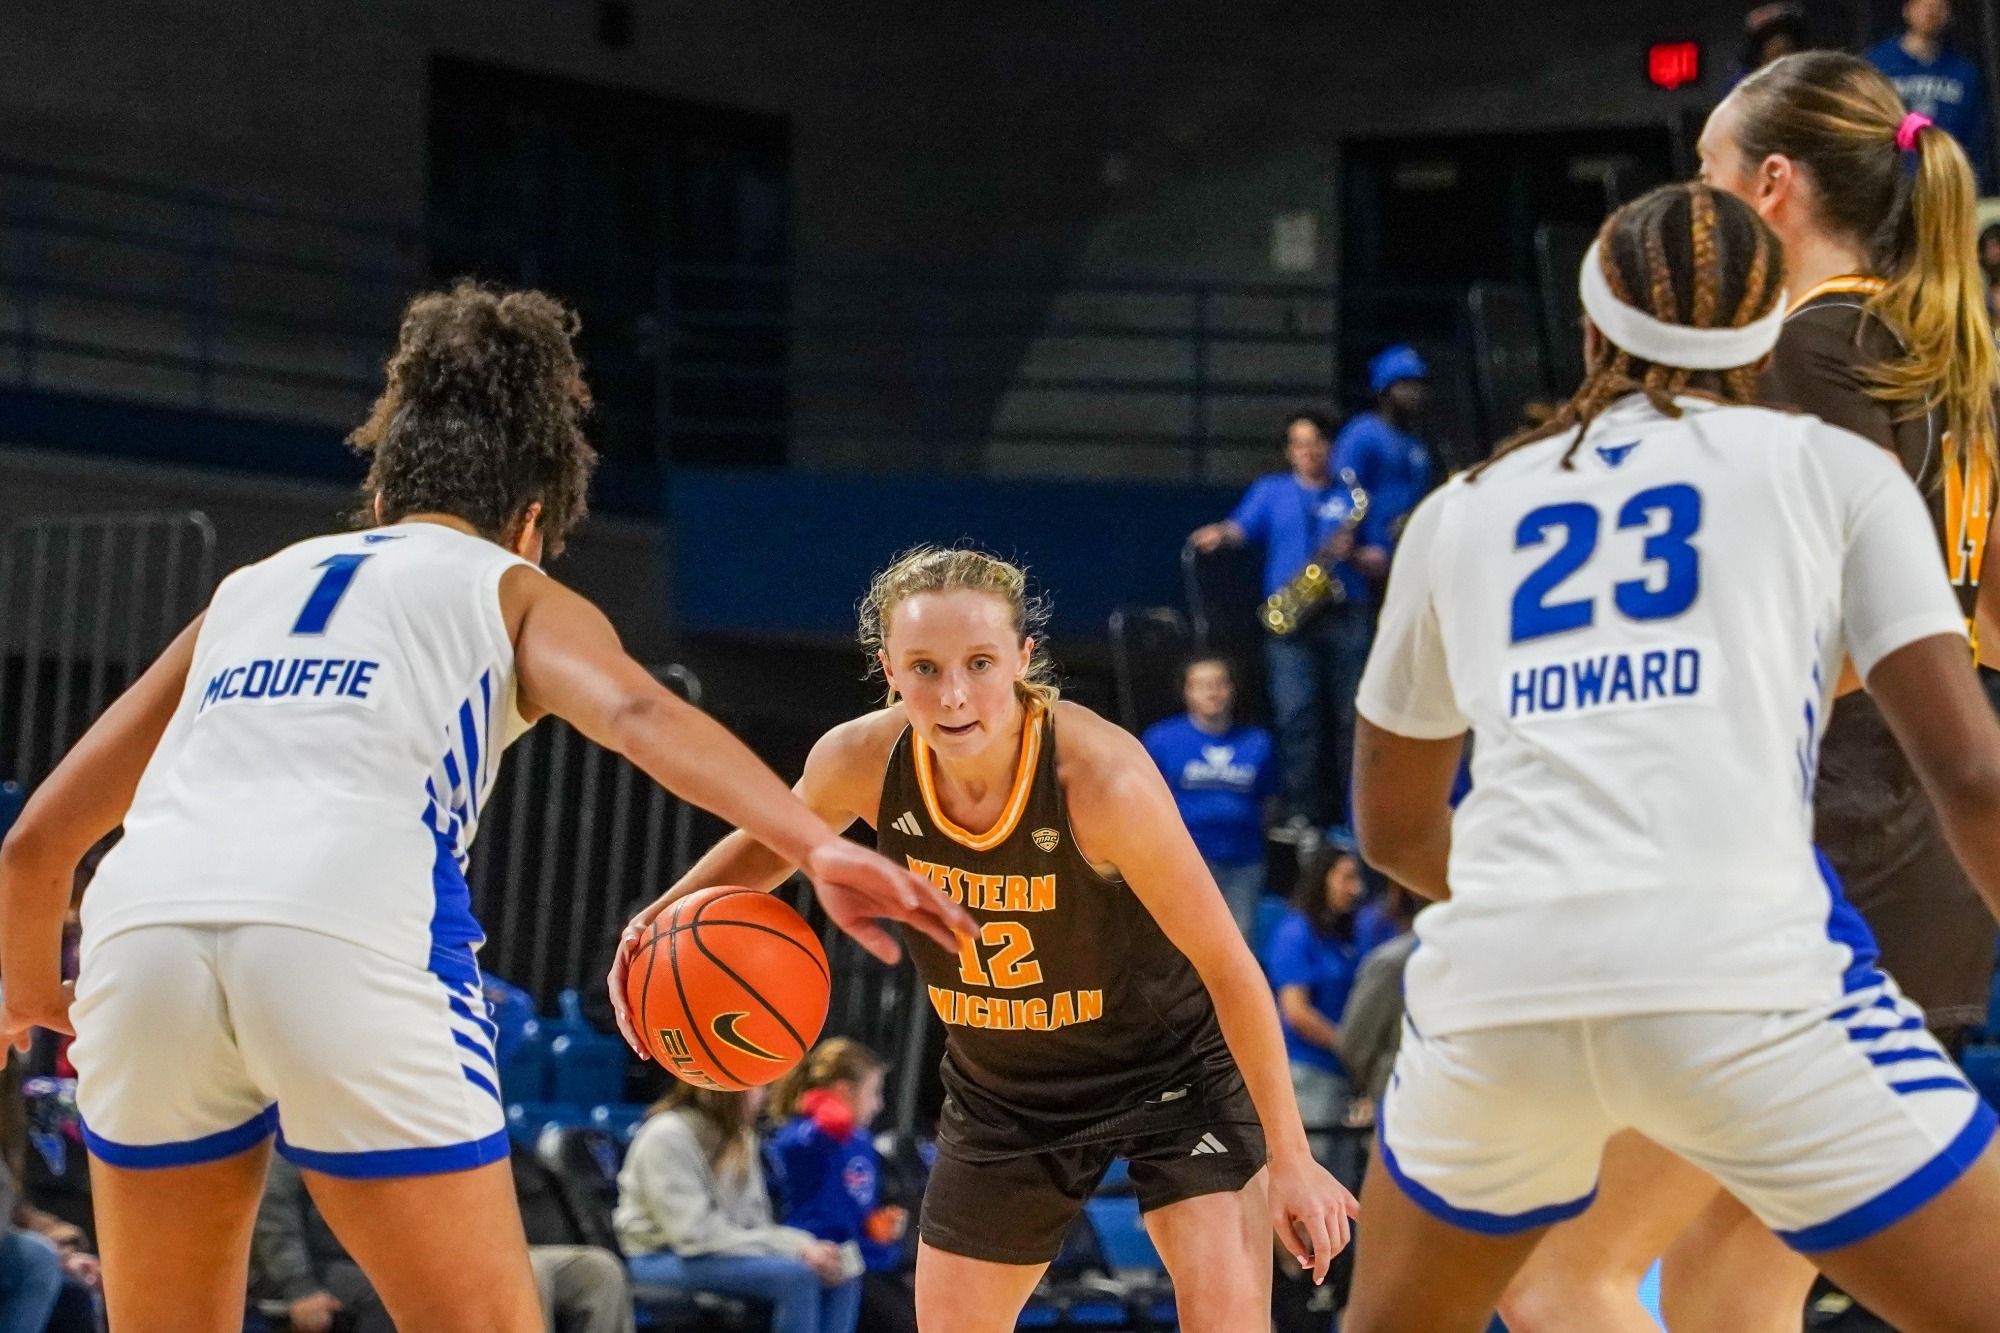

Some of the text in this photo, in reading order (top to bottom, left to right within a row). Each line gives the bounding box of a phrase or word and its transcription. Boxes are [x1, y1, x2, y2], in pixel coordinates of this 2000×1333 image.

[289, 553, 376, 637] 1
[1509, 482, 1703, 646] 23
[1510, 648, 1701, 719] HOWARD
[1035, 835, 1057, 844] MAC
[906, 854, 1056, 912] WESTERN
[954, 921, 1043, 989] 12
[928, 984, 1103, 1031] MICHIGAN
